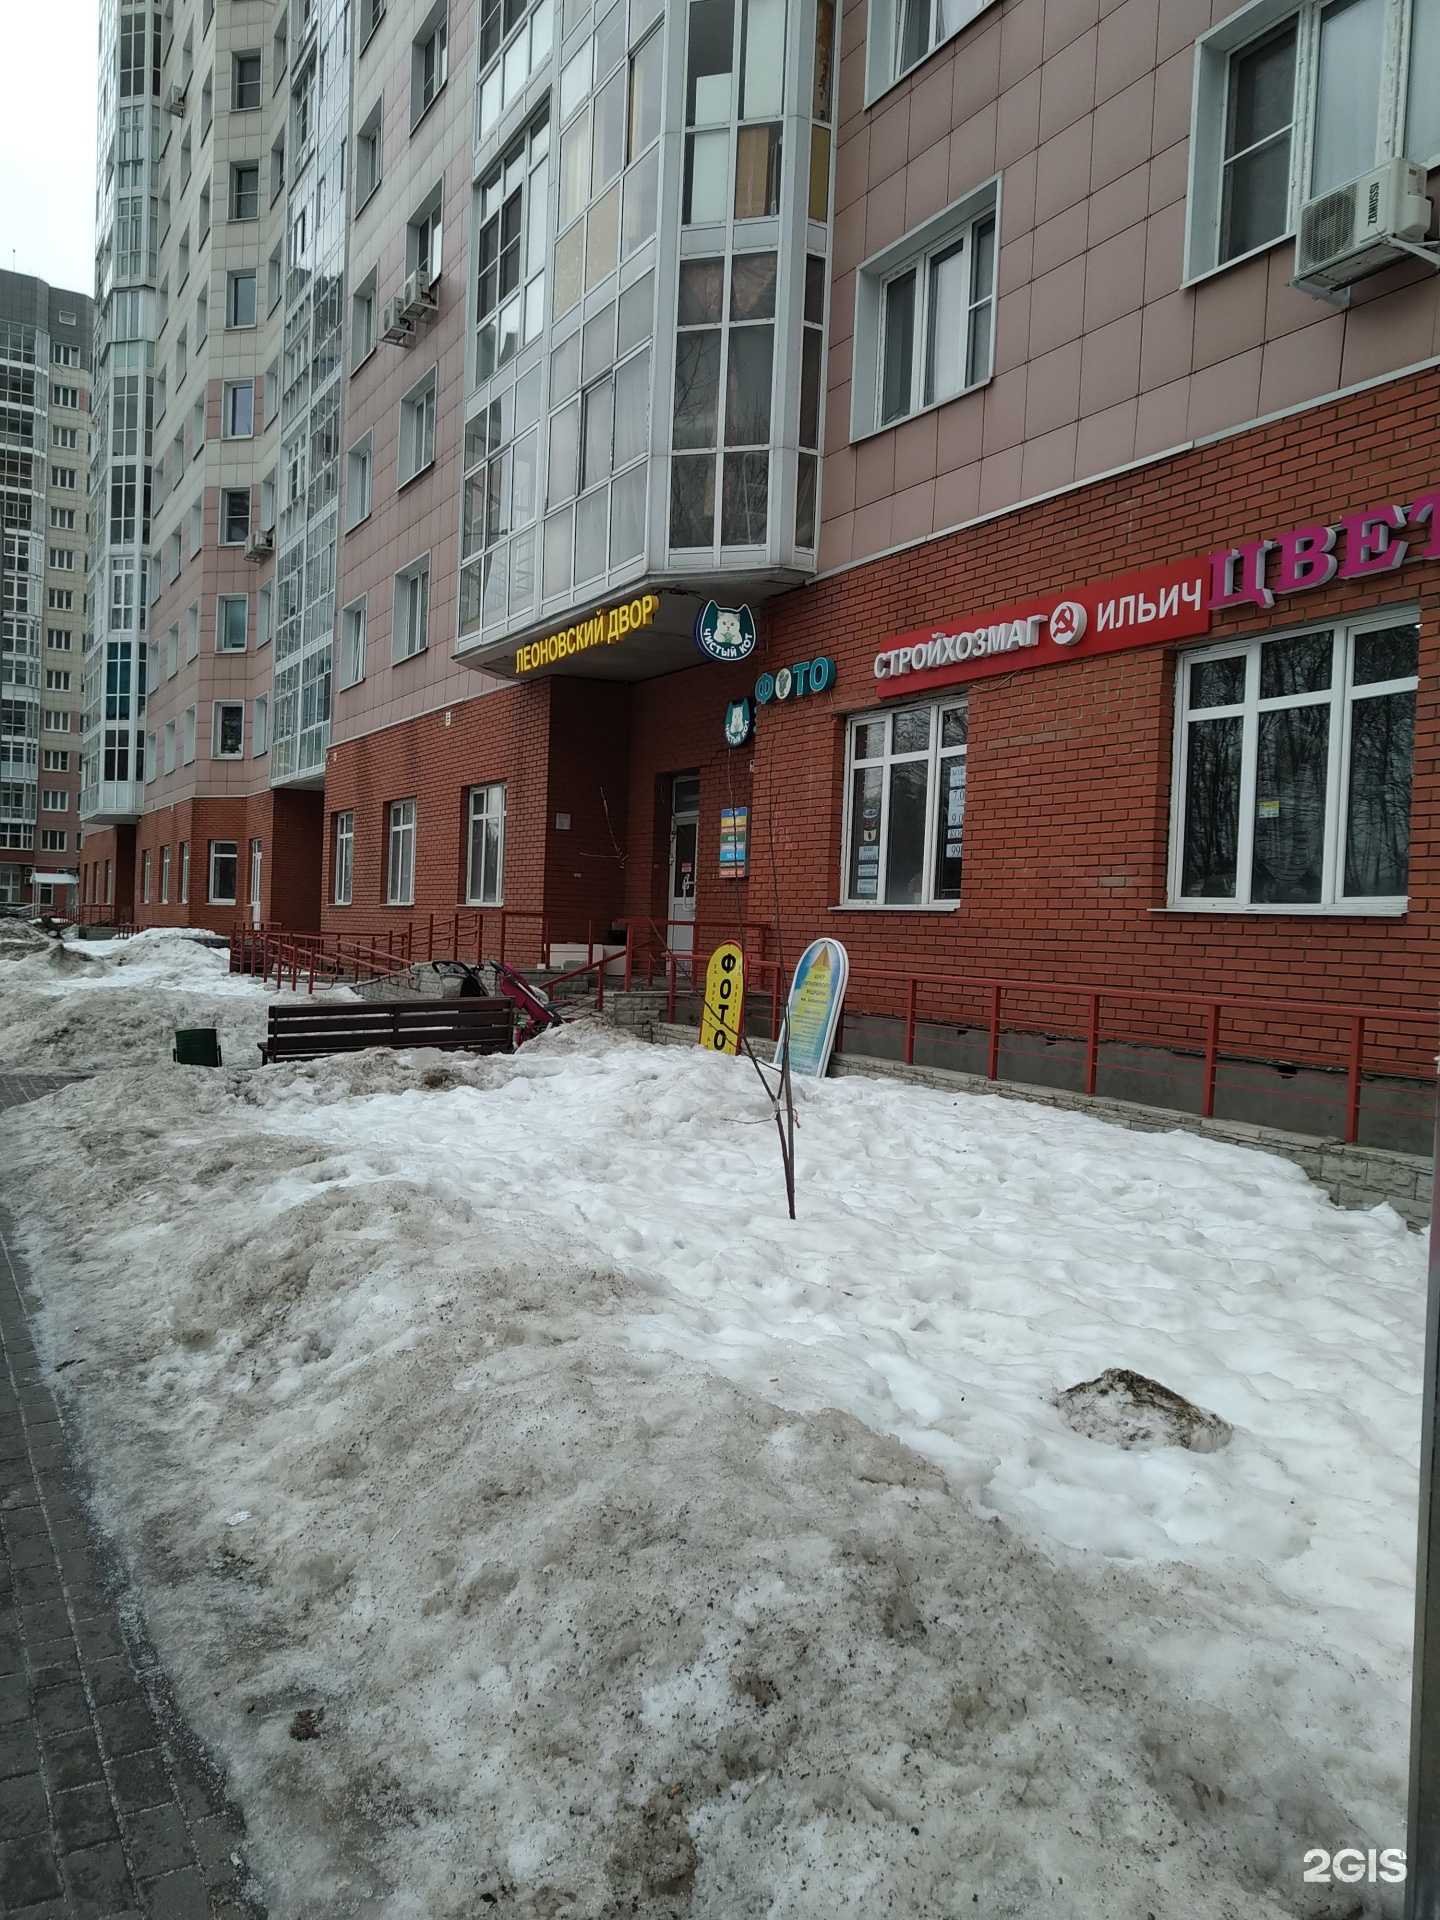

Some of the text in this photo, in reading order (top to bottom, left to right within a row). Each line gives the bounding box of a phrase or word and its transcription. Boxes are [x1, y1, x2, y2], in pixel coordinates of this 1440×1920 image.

[1367, 182, 1379, 226] ZANUSSI
[515, 594, 659, 673] ЛЕОНОВСКИЙ ДВОР
[704, 628, 754, 657] ЧИСТЫЙ КОТ
[873, 579, 1202, 680] СТРОЙХОЗМАГ ИЛЬИЧ
[754, 656, 834, 703] ФОТО
[713, 953, 737, 1050] ФОТО
